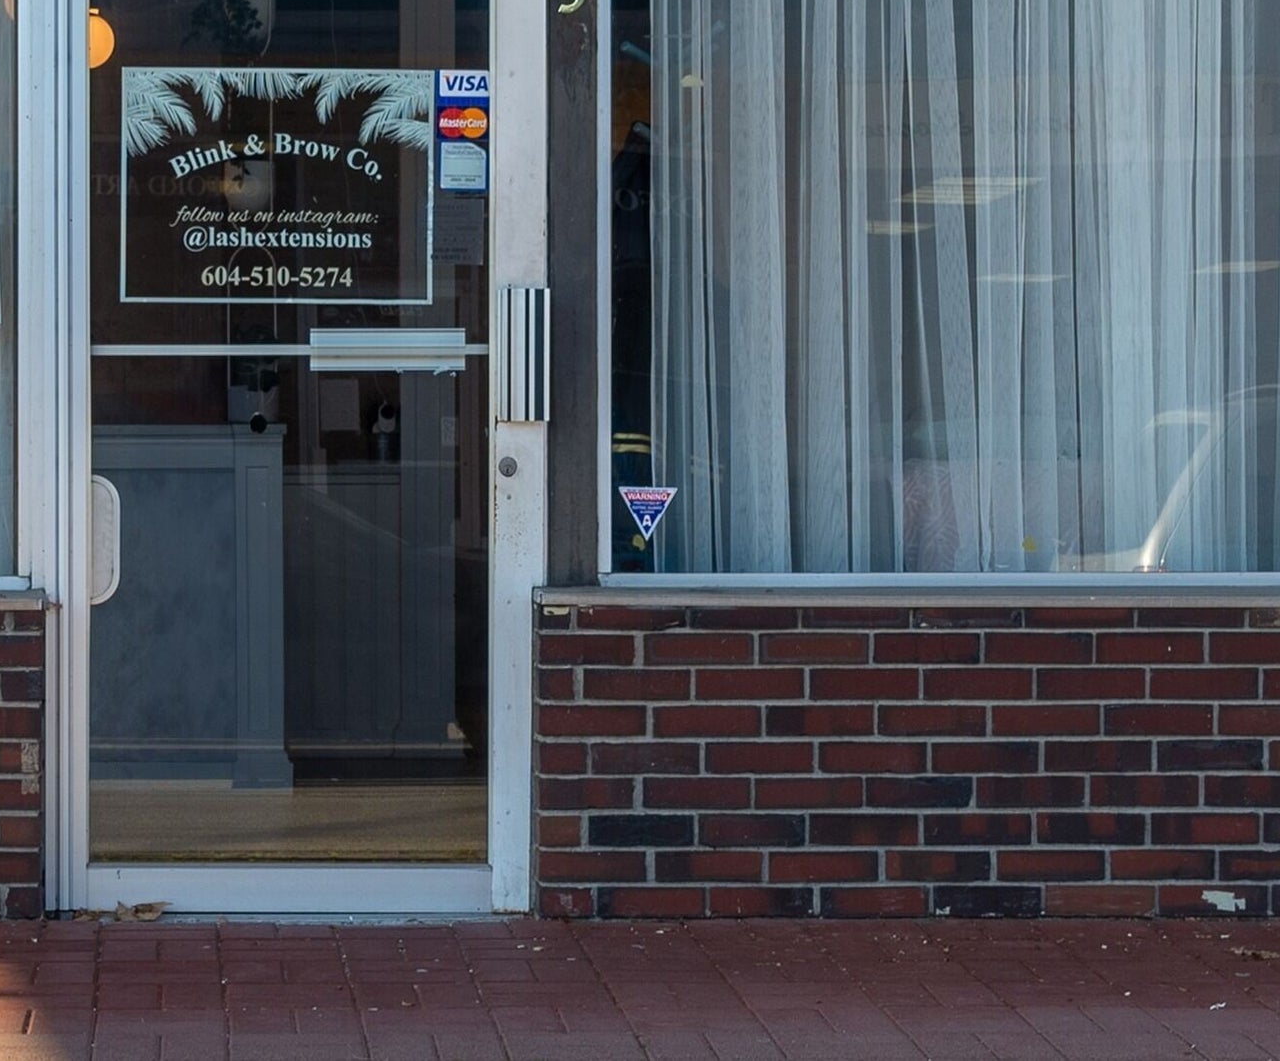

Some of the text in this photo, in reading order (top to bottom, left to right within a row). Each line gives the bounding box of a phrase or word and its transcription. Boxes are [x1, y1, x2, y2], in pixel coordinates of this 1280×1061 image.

[444, 75, 489, 92] VISA
[439, 117, 487, 129] MasterCard
[168, 132, 383, 181] Blink & Brow Co.
[169, 205, 380, 229] follow us on instagram:
[183, 226, 372, 253] @lashextensions
[200, 265, 353, 288] 604-510-5274
[626, 492, 668, 501] WARNING
